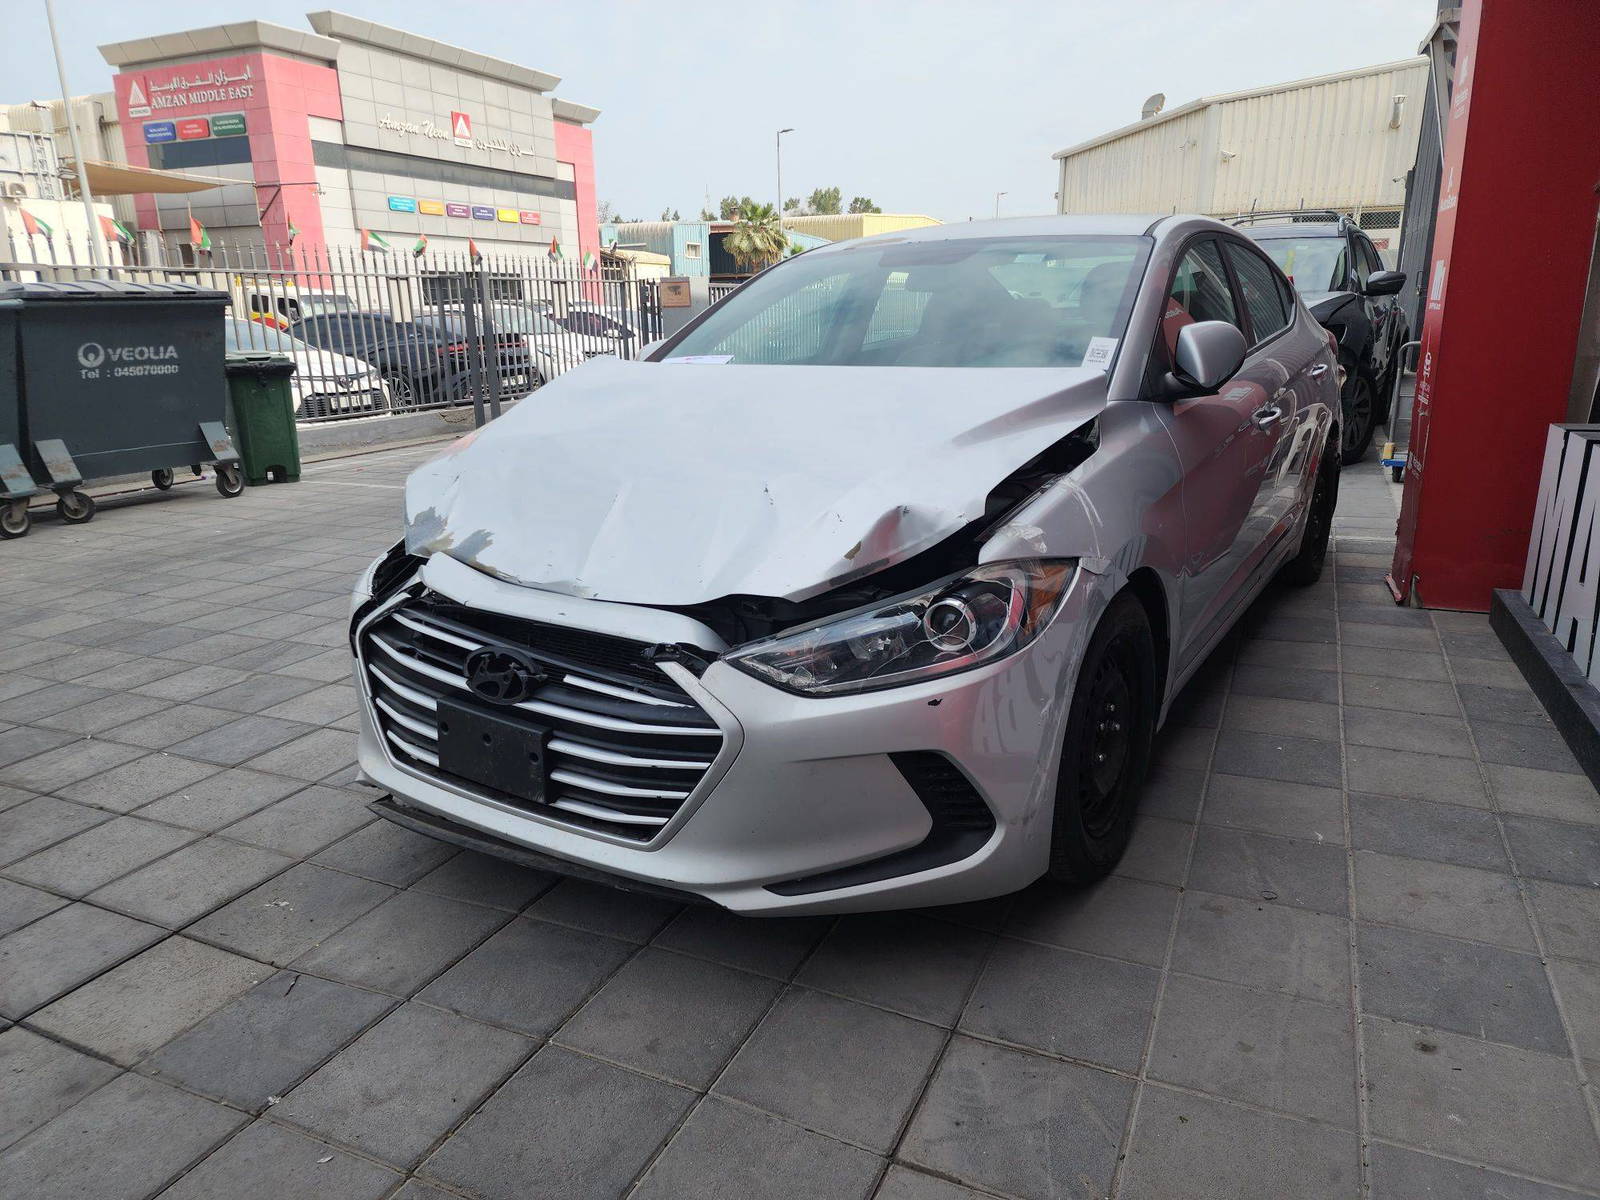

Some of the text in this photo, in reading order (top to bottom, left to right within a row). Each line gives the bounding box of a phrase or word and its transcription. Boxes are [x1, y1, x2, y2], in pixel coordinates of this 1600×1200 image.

[151, 84, 254, 109] AMZAN MIDDLE EAST
[421, 119, 449, 140] Neon
[108, 346, 178, 361] VEOLIA
[80, 368, 100, 379] Tel
[1521, 424, 1600, 693] MA
